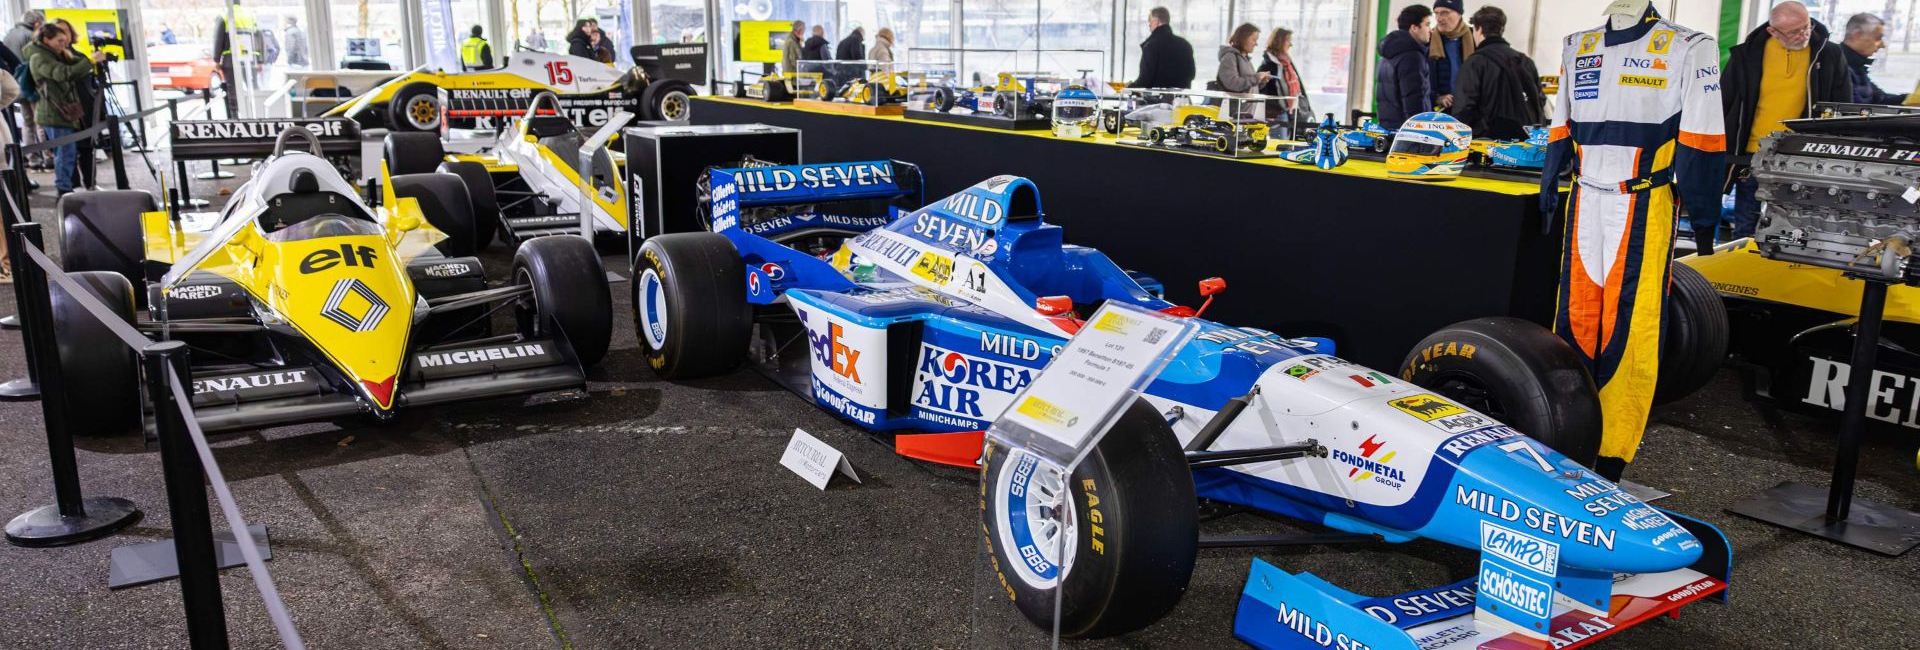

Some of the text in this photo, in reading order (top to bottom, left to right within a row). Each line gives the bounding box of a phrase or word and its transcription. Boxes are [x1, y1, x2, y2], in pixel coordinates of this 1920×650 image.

[661, 46, 704, 56] MICHELIN
[1576, 56, 1593, 68] elf
[1623, 57, 1650, 69] ING
[544, 61, 574, 86] 15
[1621, 76, 1665, 86] RENAULT
[1695, 66, 1719, 79] ING
[453, 88, 532, 99] RENAULT elf
[176, 121, 343, 139] RENAULT elf
[1801, 142, 1917, 162] RENAULT F1
[733, 161, 893, 194] MILD SEVEN
[712, 182, 736, 203] Gillette
[512, 215, 577, 224] GOODYEAR
[942, 192, 1003, 225] MILD
[712, 214, 737, 233] Gillette
[754, 216, 792, 234] SEVEN
[823, 213, 851, 226] MILD
[852, 216, 888, 227] SEVEN
[913, 212, 986, 252] SEVEN
[299, 243, 379, 275] elf
[861, 233, 921, 267] RENAULT
[417, 344, 545, 368] MICHELIN
[980, 330, 1041, 361] MILD
[821, 388, 876, 425] GOODYEAR
[915, 379, 984, 418] AIR
[918, 410, 979, 430] MINICHAMPS
[1438, 414, 1484, 430] Agip
[1332, 449, 1406, 483] FONDMETAL
[1497, 440, 1555, 472] 7
[1375, 476, 1402, 491] GROUP
[1082, 478, 1105, 556] EAGLE
[1456, 484, 1617, 551] MILD SEVEN
[1020, 544, 1050, 574] BBS
[1486, 529, 1544, 566] LAMPO
[1545, 544, 1557, 574] ZIPPERS
[1482, 568, 1546, 615] SCHÖSSTEC
[1667, 580, 1716, 602] GOODYEAR
[1277, 601, 1333, 647] MILD
[1549, 616, 1616, 650] AKAI
